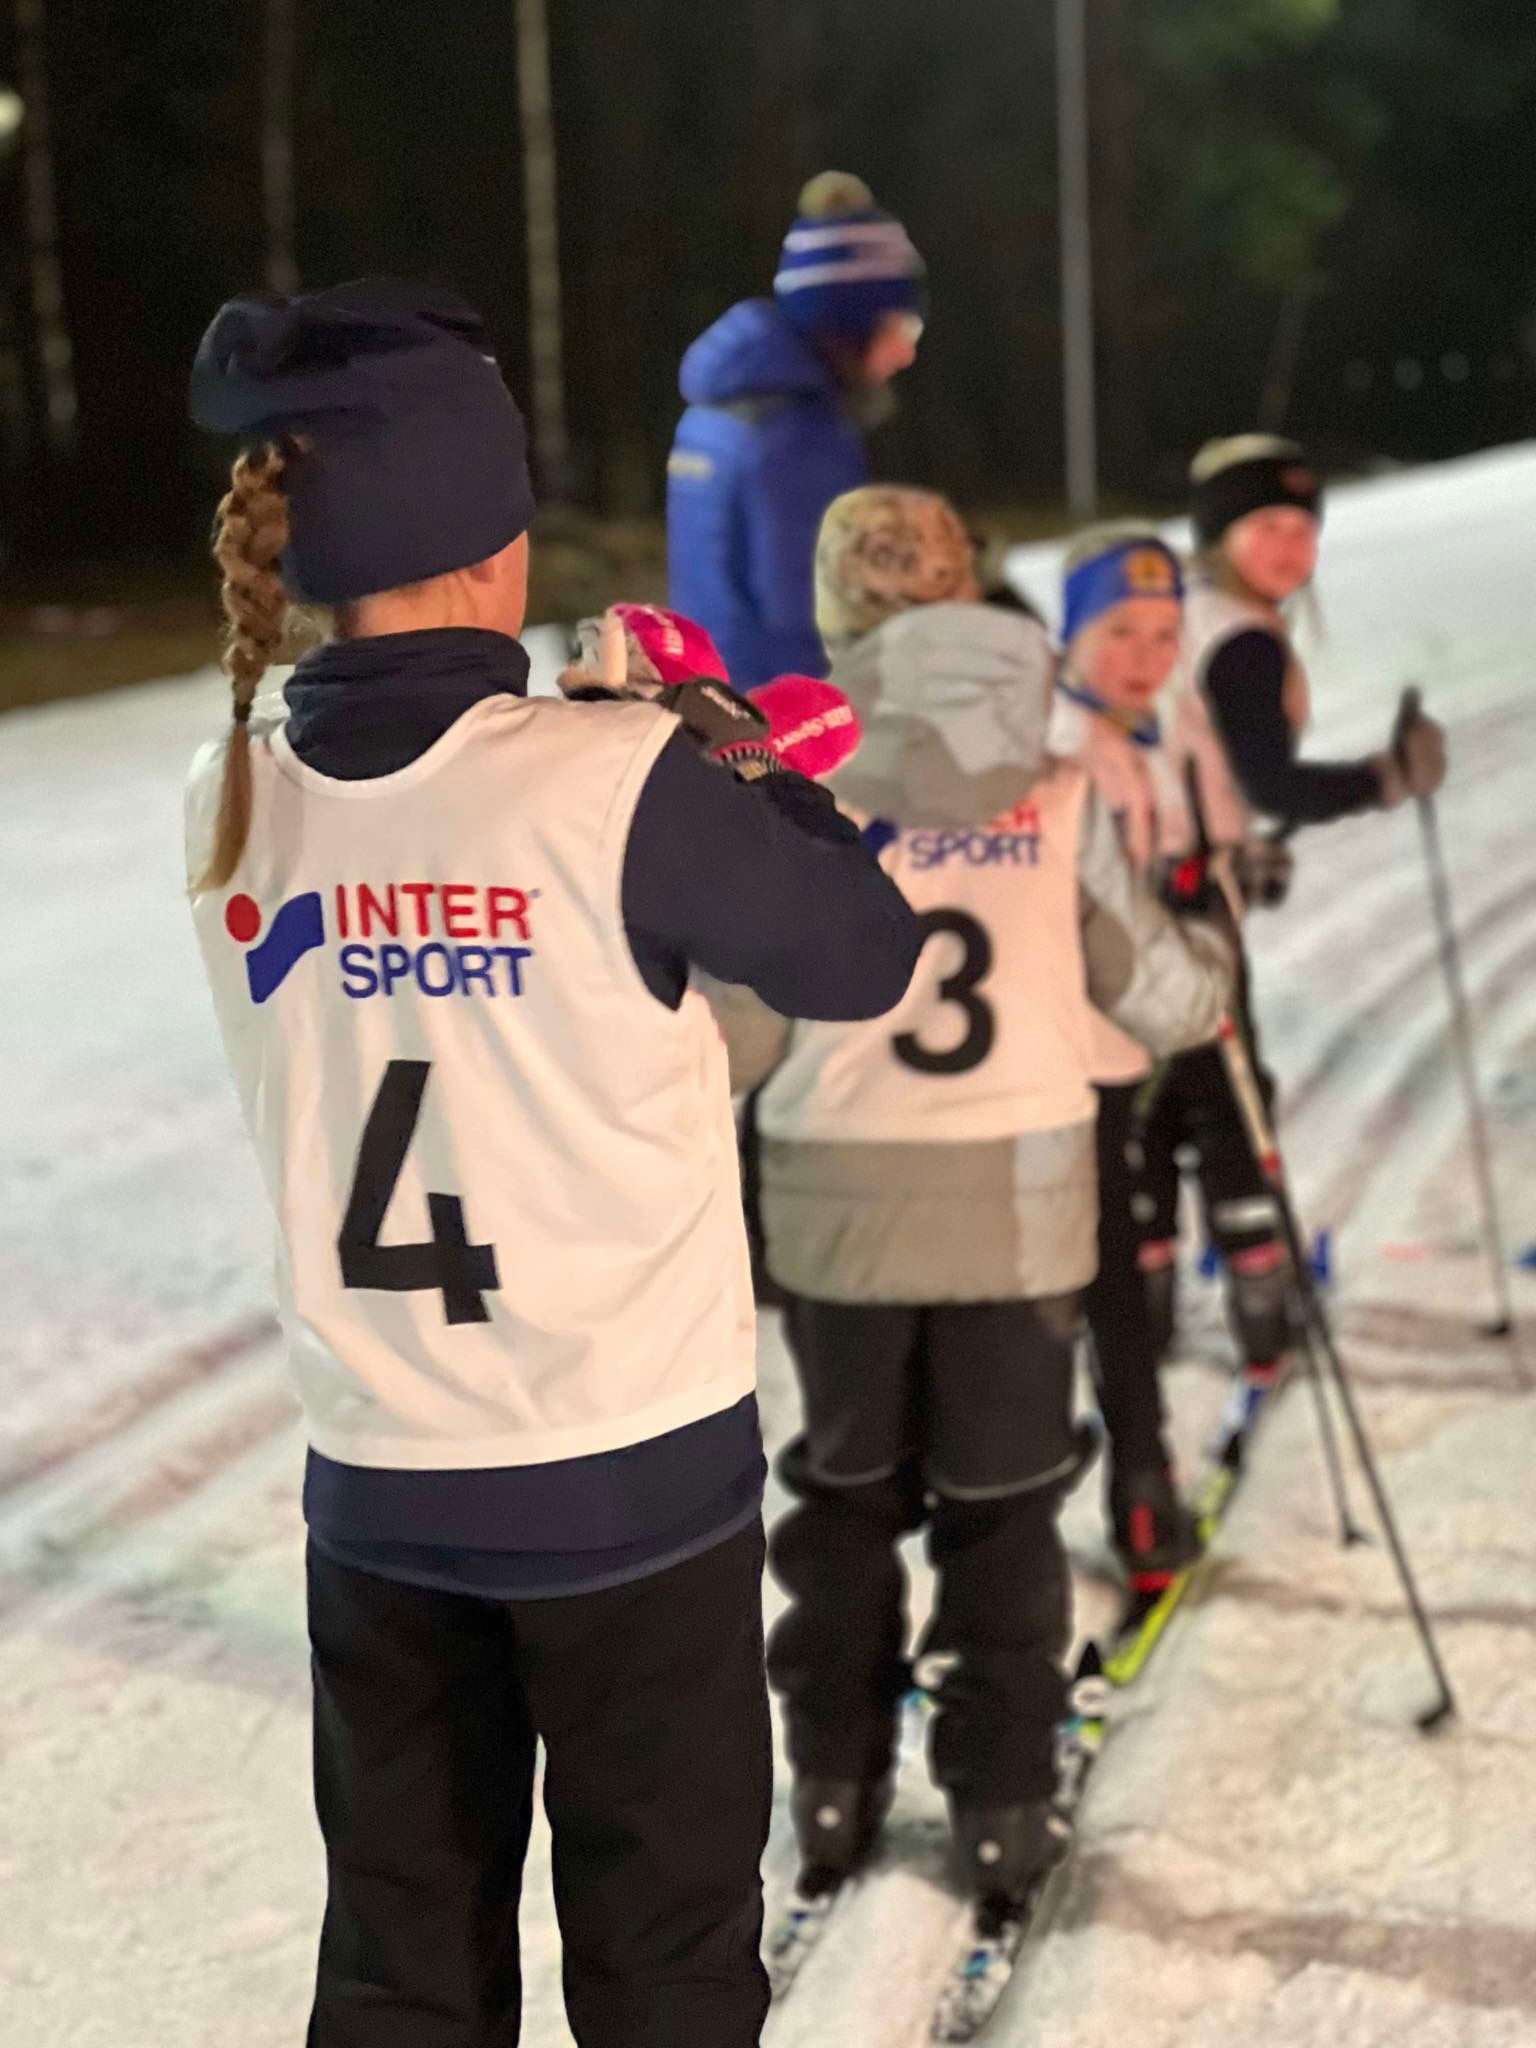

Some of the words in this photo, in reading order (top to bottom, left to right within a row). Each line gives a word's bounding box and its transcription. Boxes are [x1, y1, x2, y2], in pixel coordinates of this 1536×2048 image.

[910, 831, 1040, 870] SPORT
[335, 883, 533, 940] INTER
[340, 942, 534, 999] SPORT
[891, 907, 995, 1077] 3
[338, 1059, 502, 1325] 4
